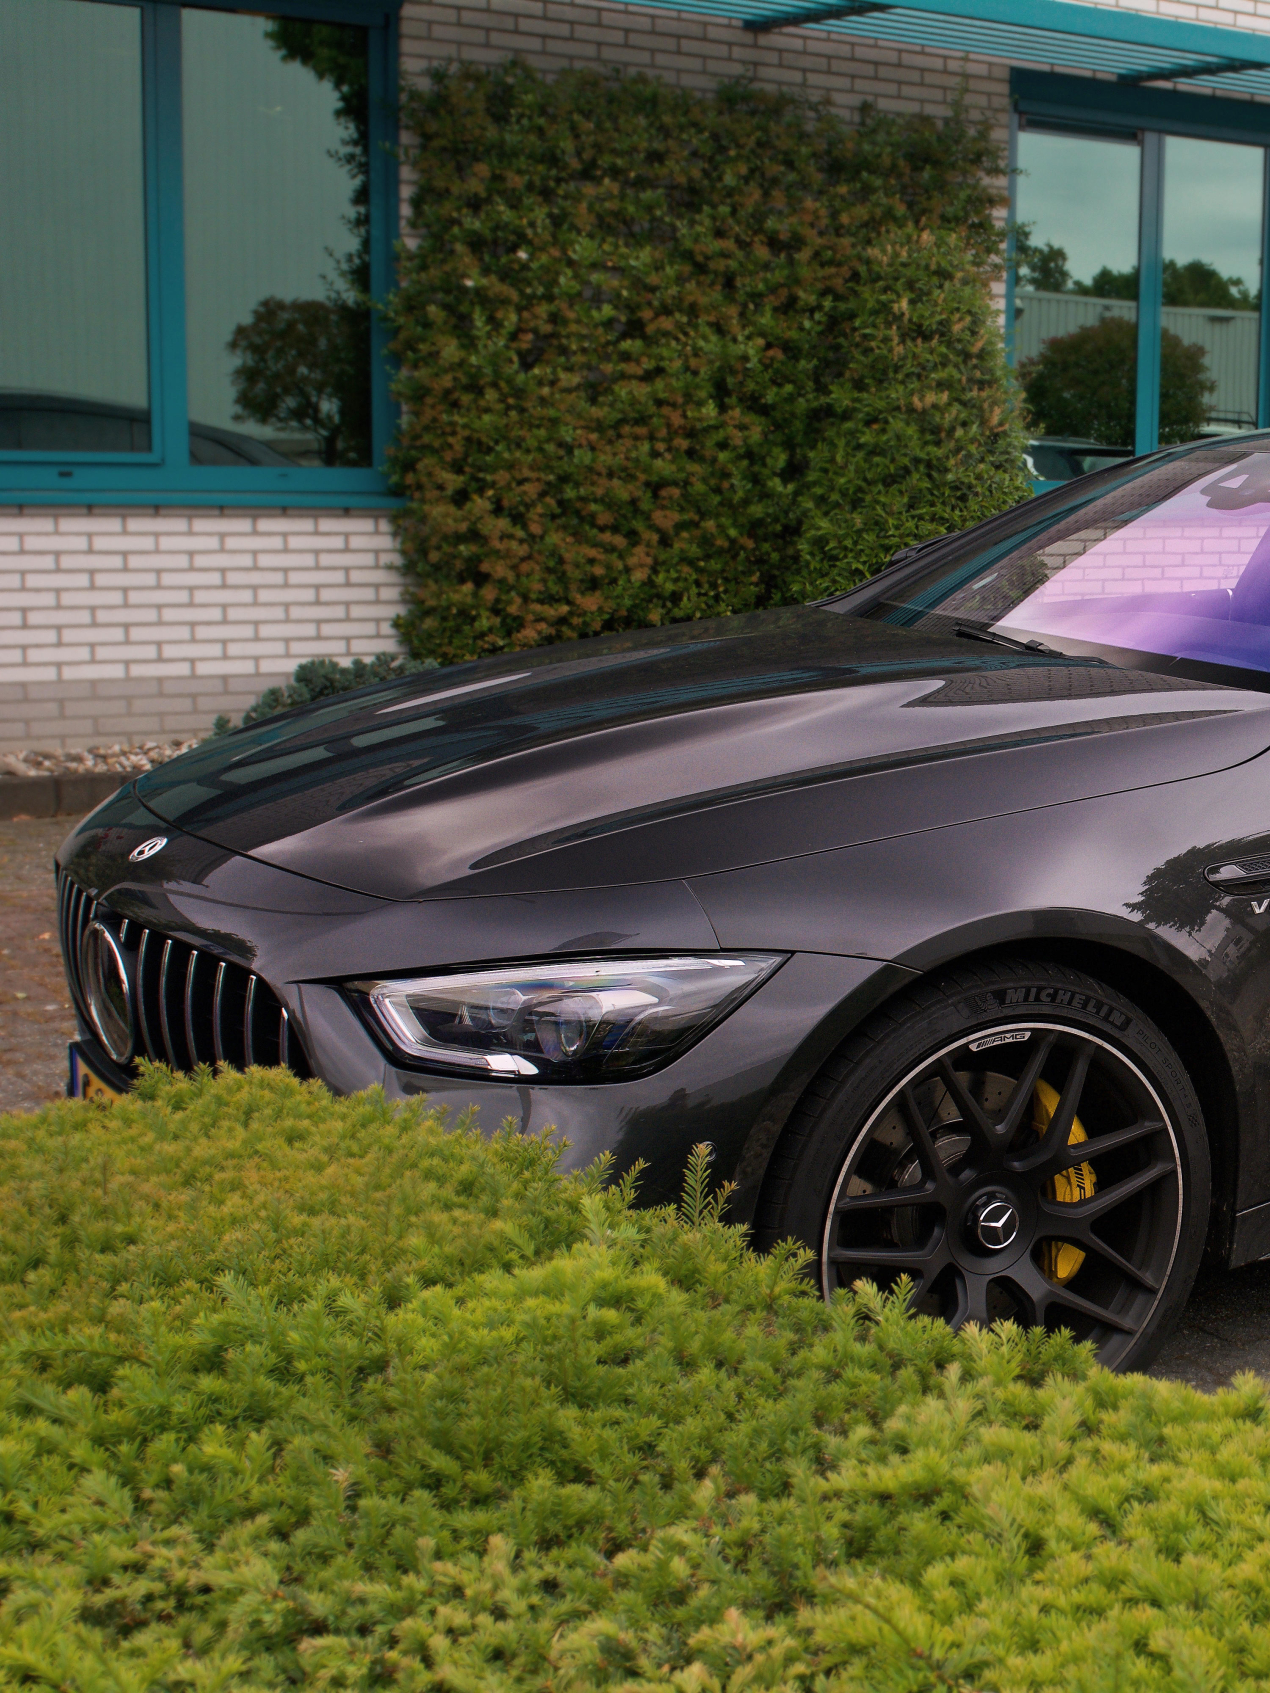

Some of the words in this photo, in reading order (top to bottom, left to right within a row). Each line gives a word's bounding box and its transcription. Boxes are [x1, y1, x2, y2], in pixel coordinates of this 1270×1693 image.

[1005, 988, 1127, 1027] MICHELIN
[991, 1032, 1026, 1046] AMG
[1136, 1028, 1162, 1054] PILOT
[1161, 1058, 1186, 1092] SPORT
